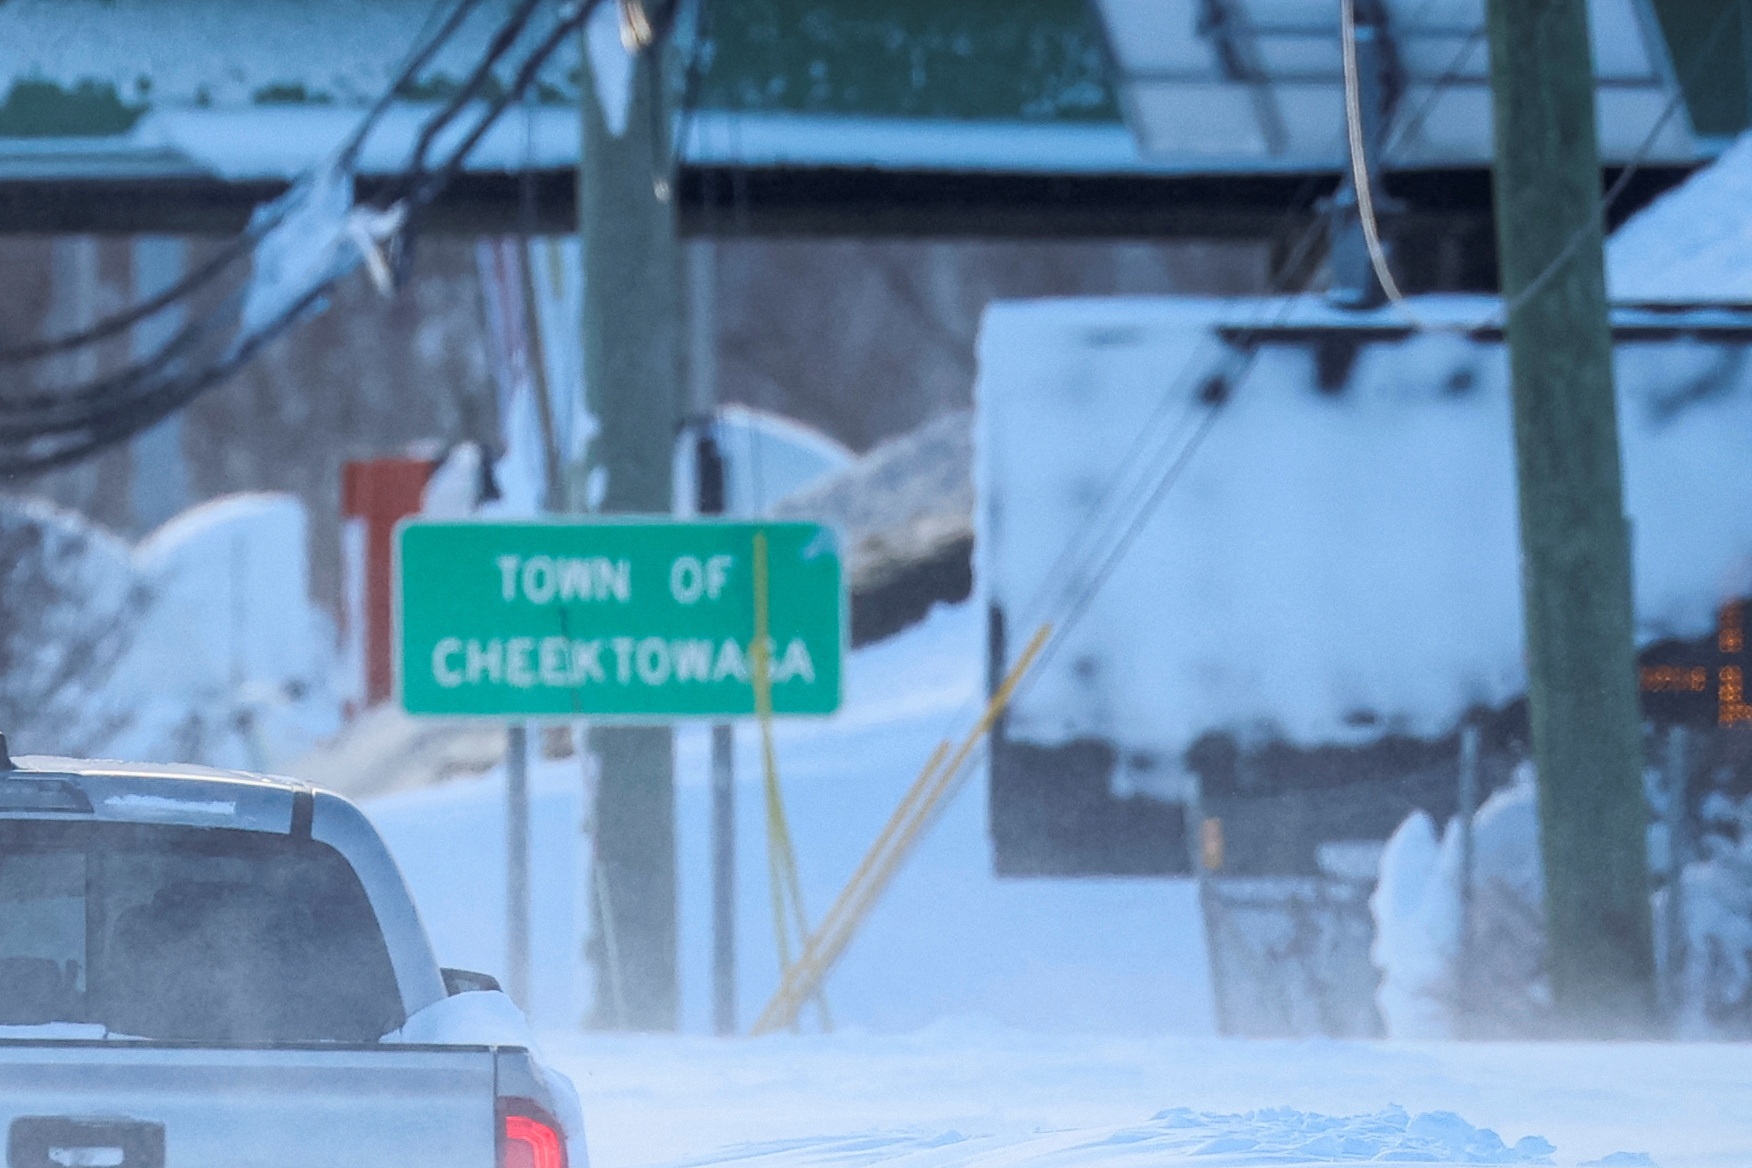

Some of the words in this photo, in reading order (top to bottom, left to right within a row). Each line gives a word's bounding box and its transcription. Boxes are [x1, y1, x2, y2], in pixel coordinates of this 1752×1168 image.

[497, 555, 631, 604] TOWN
[671, 554, 734, 604] OF
[432, 636, 816, 688] CHEEKTOWAGA
